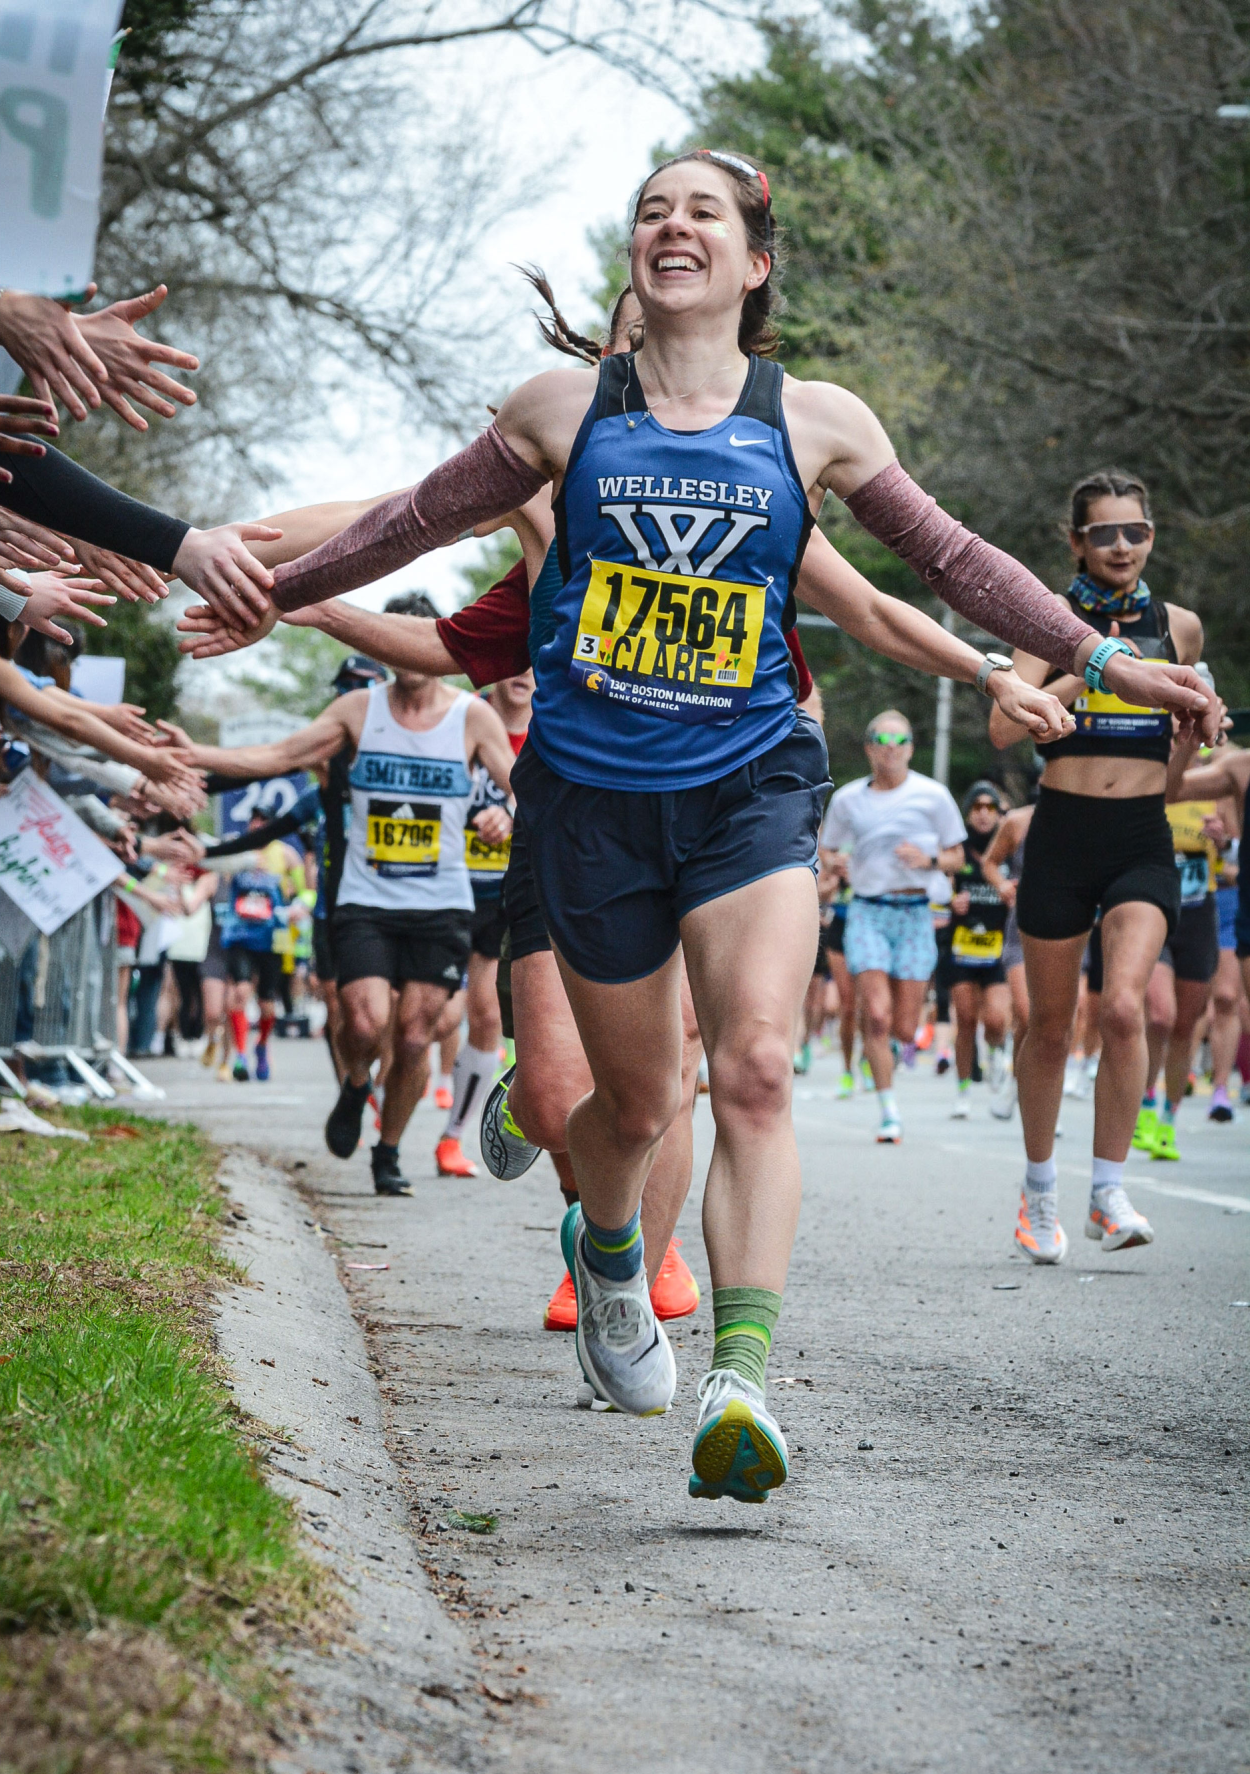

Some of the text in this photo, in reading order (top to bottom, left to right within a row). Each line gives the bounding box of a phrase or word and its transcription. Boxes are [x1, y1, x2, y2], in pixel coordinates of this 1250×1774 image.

[598, 476, 773, 511] WELLESLEY
[600, 503, 769, 578] W
[601, 572, 748, 655] 17564
[580, 636, 596, 655] 3
[611, 635, 716, 697] CLARE
[608, 691, 630, 702] BANK
[631, 696, 642, 705] OF
[643, 699, 680, 712] AMERICA
[631, 683, 674, 702] BOSTON
[675, 691, 733, 709] MARATHON
[365, 758, 454, 789] SMITHERS
